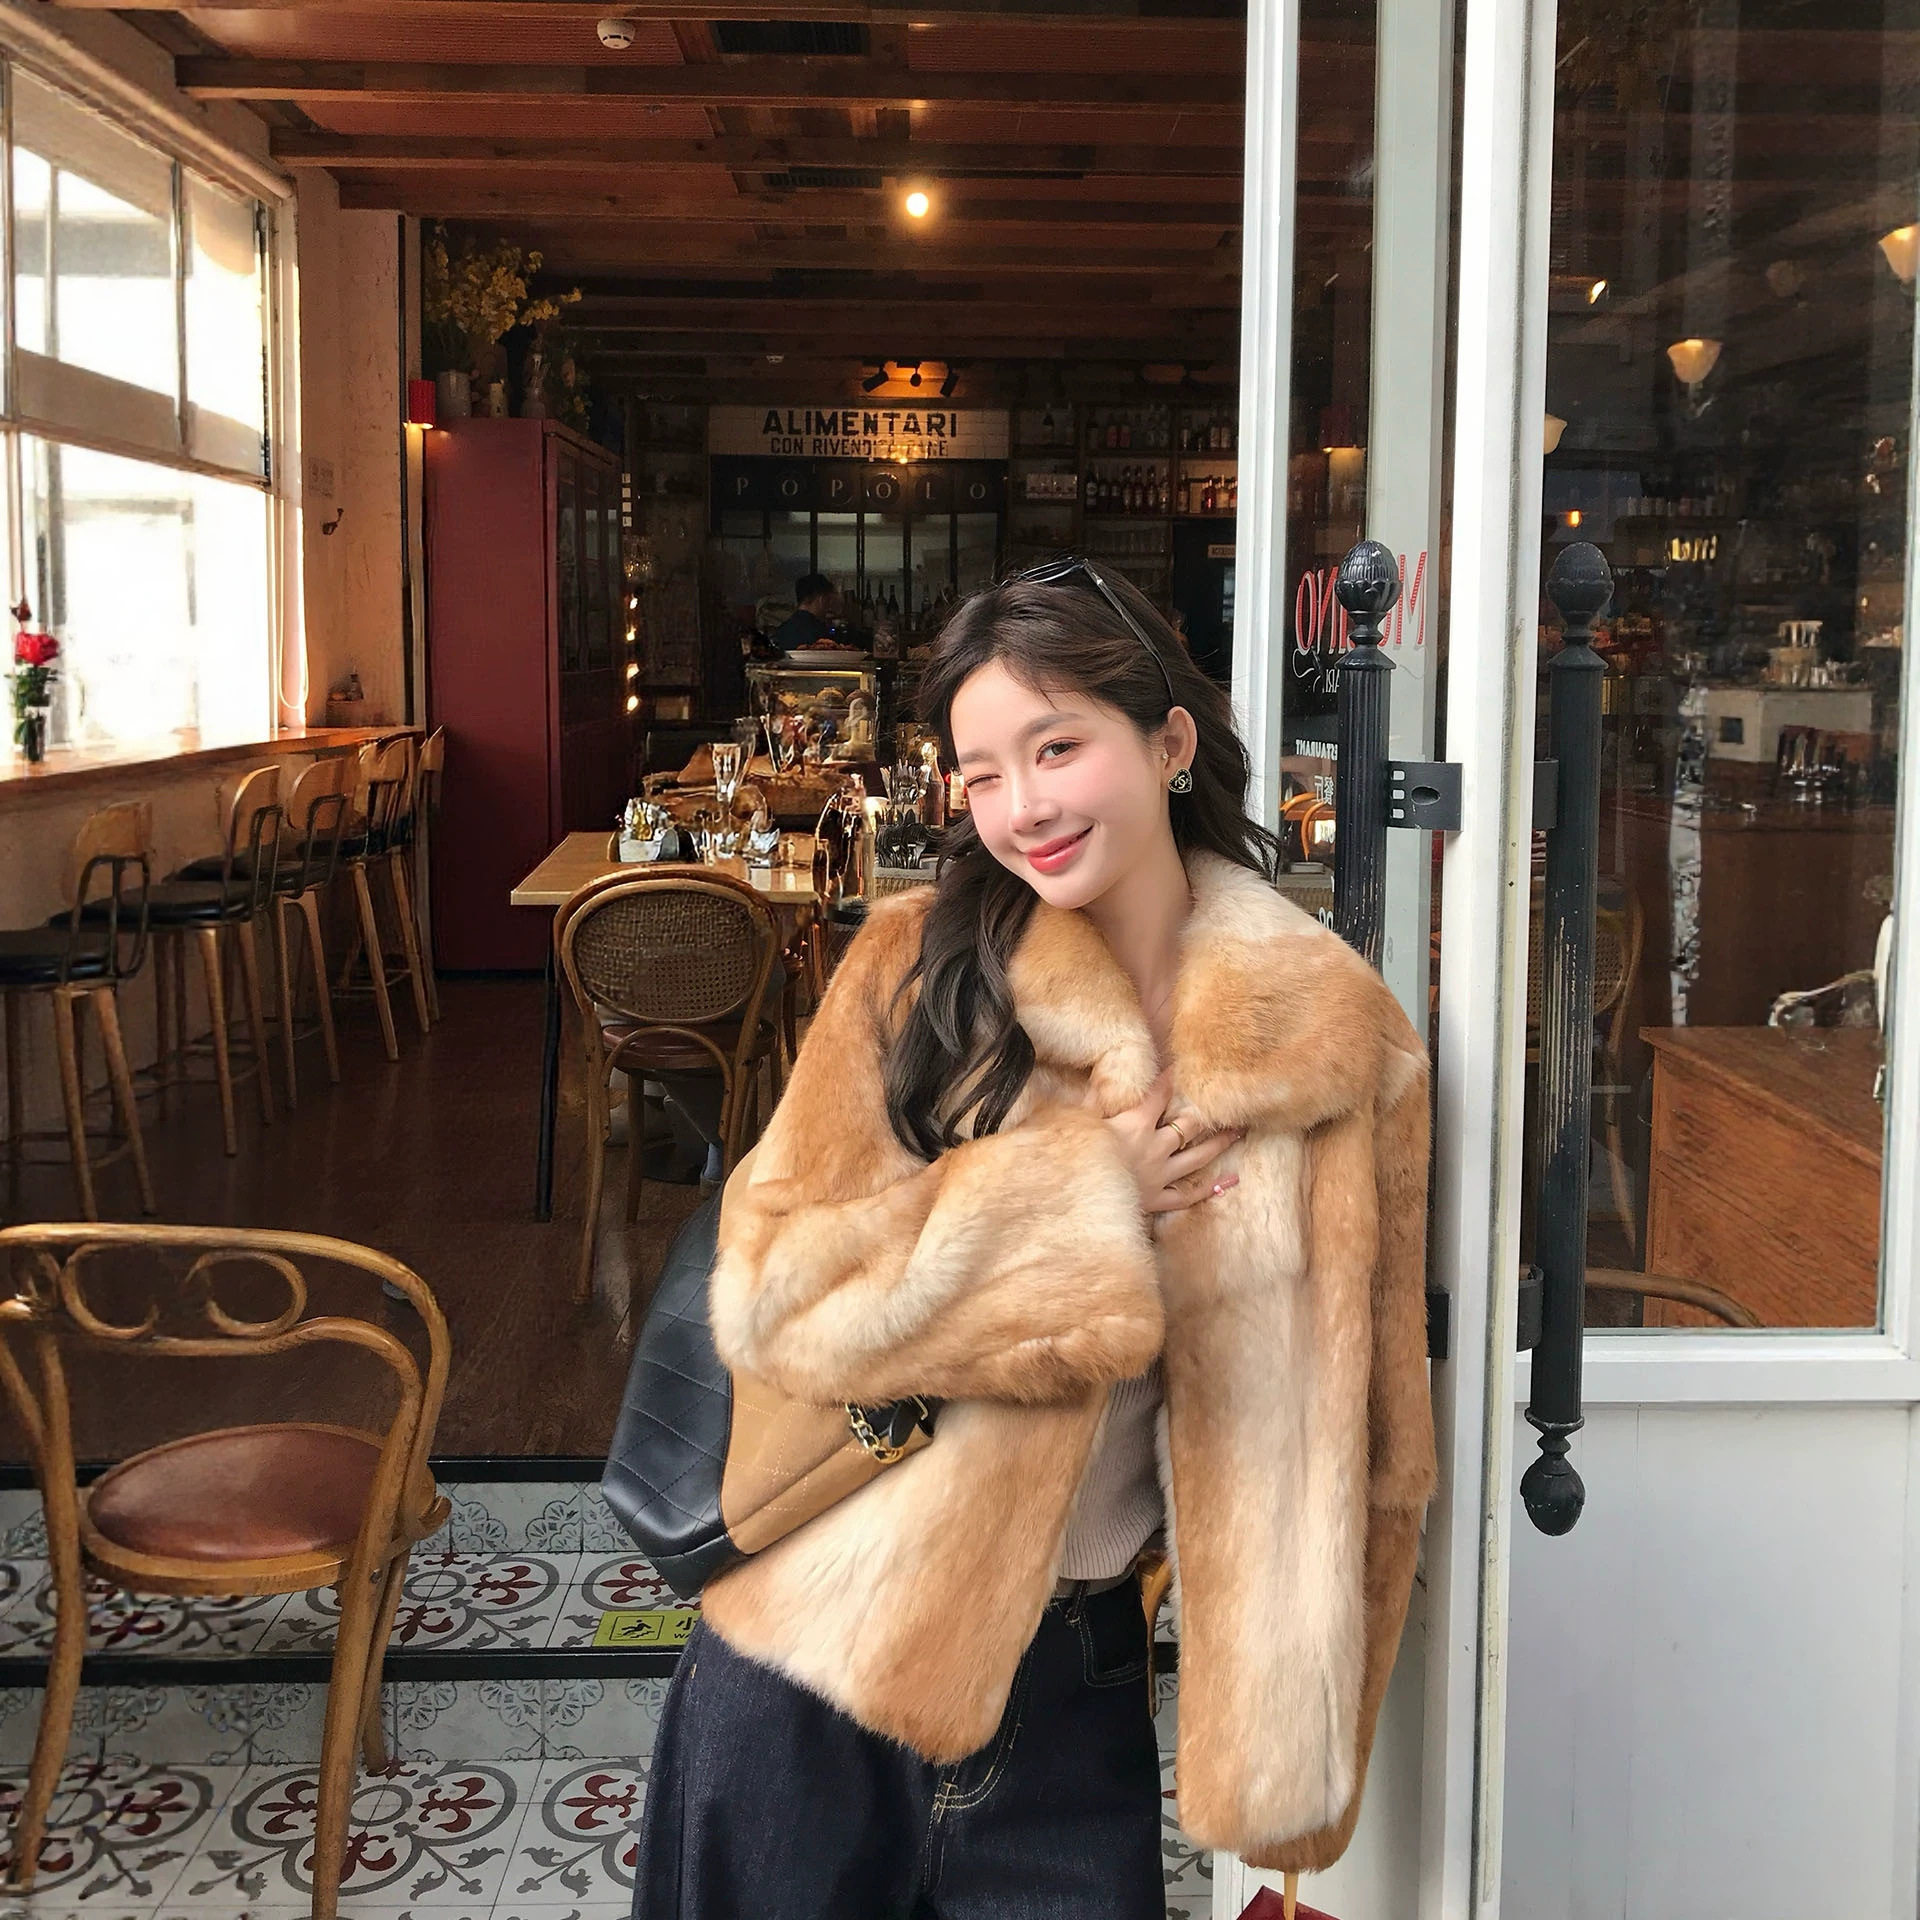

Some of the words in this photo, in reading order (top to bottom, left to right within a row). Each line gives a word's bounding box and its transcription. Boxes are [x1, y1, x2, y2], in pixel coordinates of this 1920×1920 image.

[762, 409, 957, 438] ALIMENTARI
[771, 437, 804, 455] CON
[736, 476, 986, 500] POPOLO
